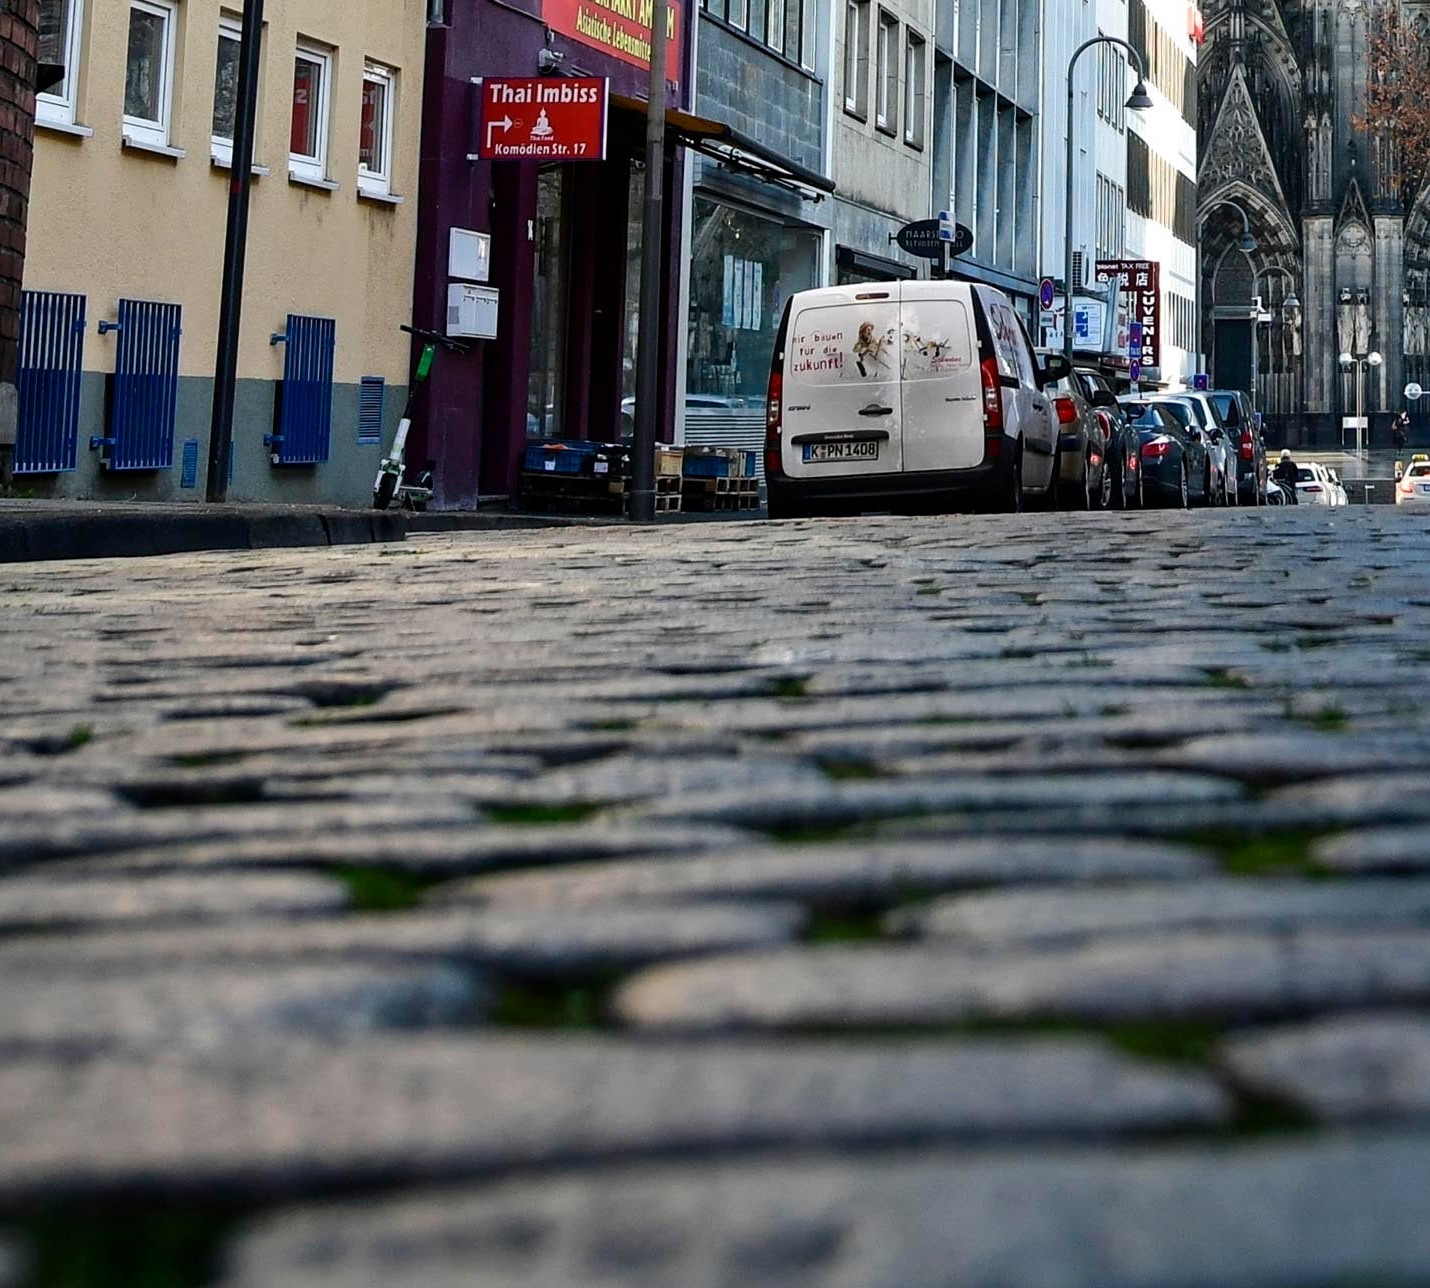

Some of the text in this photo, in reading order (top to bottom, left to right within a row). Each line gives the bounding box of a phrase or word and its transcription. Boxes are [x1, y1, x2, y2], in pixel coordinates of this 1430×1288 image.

[576, 5, 611, 45] Asiatische
[613, 21, 651, 63] Lebensmitte
[490, 83, 598, 103] Thai Imbiss
[495, 143, 587, 155] Komödien Str. 17
[814, 332, 843, 343] bauen
[793, 352, 843, 372] zukunft!
[811, 442, 875, 458] K PN 1408
